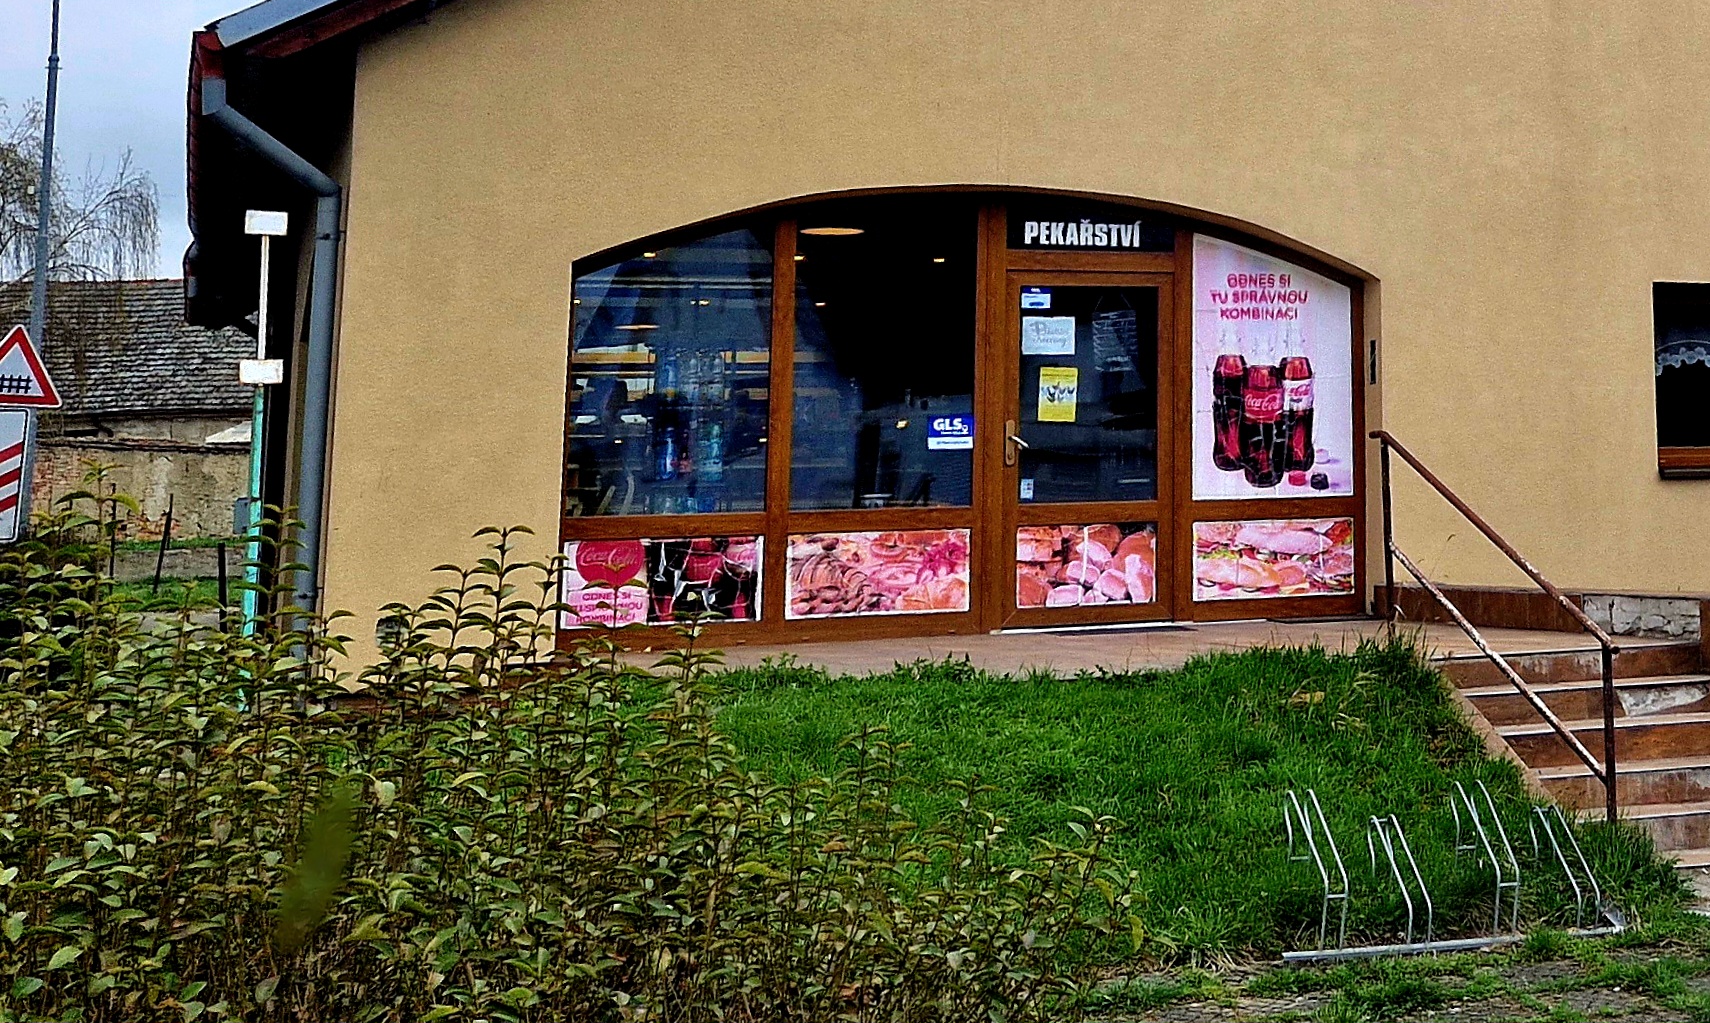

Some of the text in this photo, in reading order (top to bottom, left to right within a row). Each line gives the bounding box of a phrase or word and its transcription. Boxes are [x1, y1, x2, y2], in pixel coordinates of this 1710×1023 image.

[1024, 218, 1142, 248] PEKAŘSTVÍ
[1279, 274, 1291, 289] SI
[1232, 287, 1308, 304] SPRÁVNOU
[1220, 307, 1298, 320] KOMBINACI
[933, 418, 962, 431] GLS
